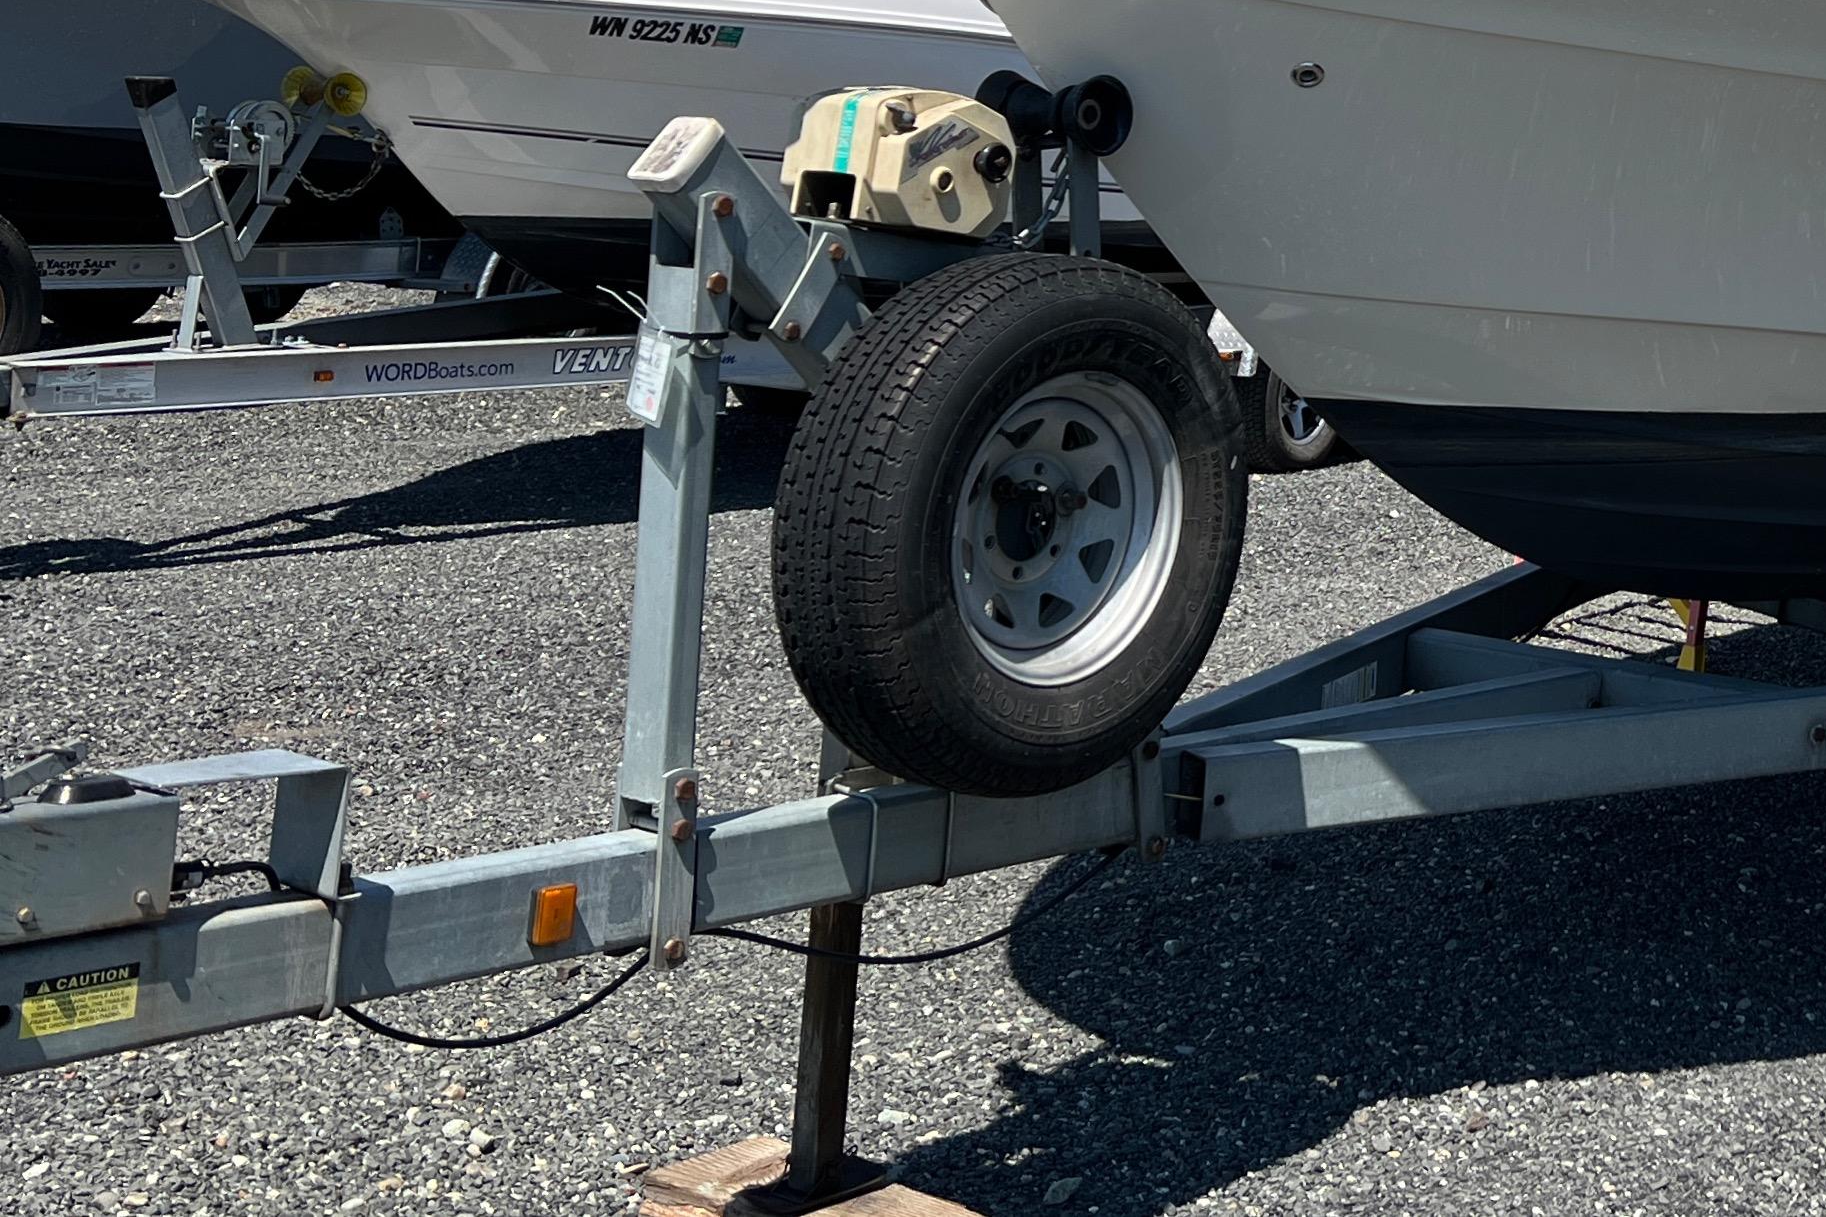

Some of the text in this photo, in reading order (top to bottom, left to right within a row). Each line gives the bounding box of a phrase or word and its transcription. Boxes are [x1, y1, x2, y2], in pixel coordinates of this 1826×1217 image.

[588, 16, 628, 37] WN
[628, 19, 684, 43] 9225
[682, 23, 715, 45] NS
[365, 361, 515, 382] WORDBoats.com
[974, 648, 1169, 728] MARATHON
[56, 966, 129, 991] CAUTION
